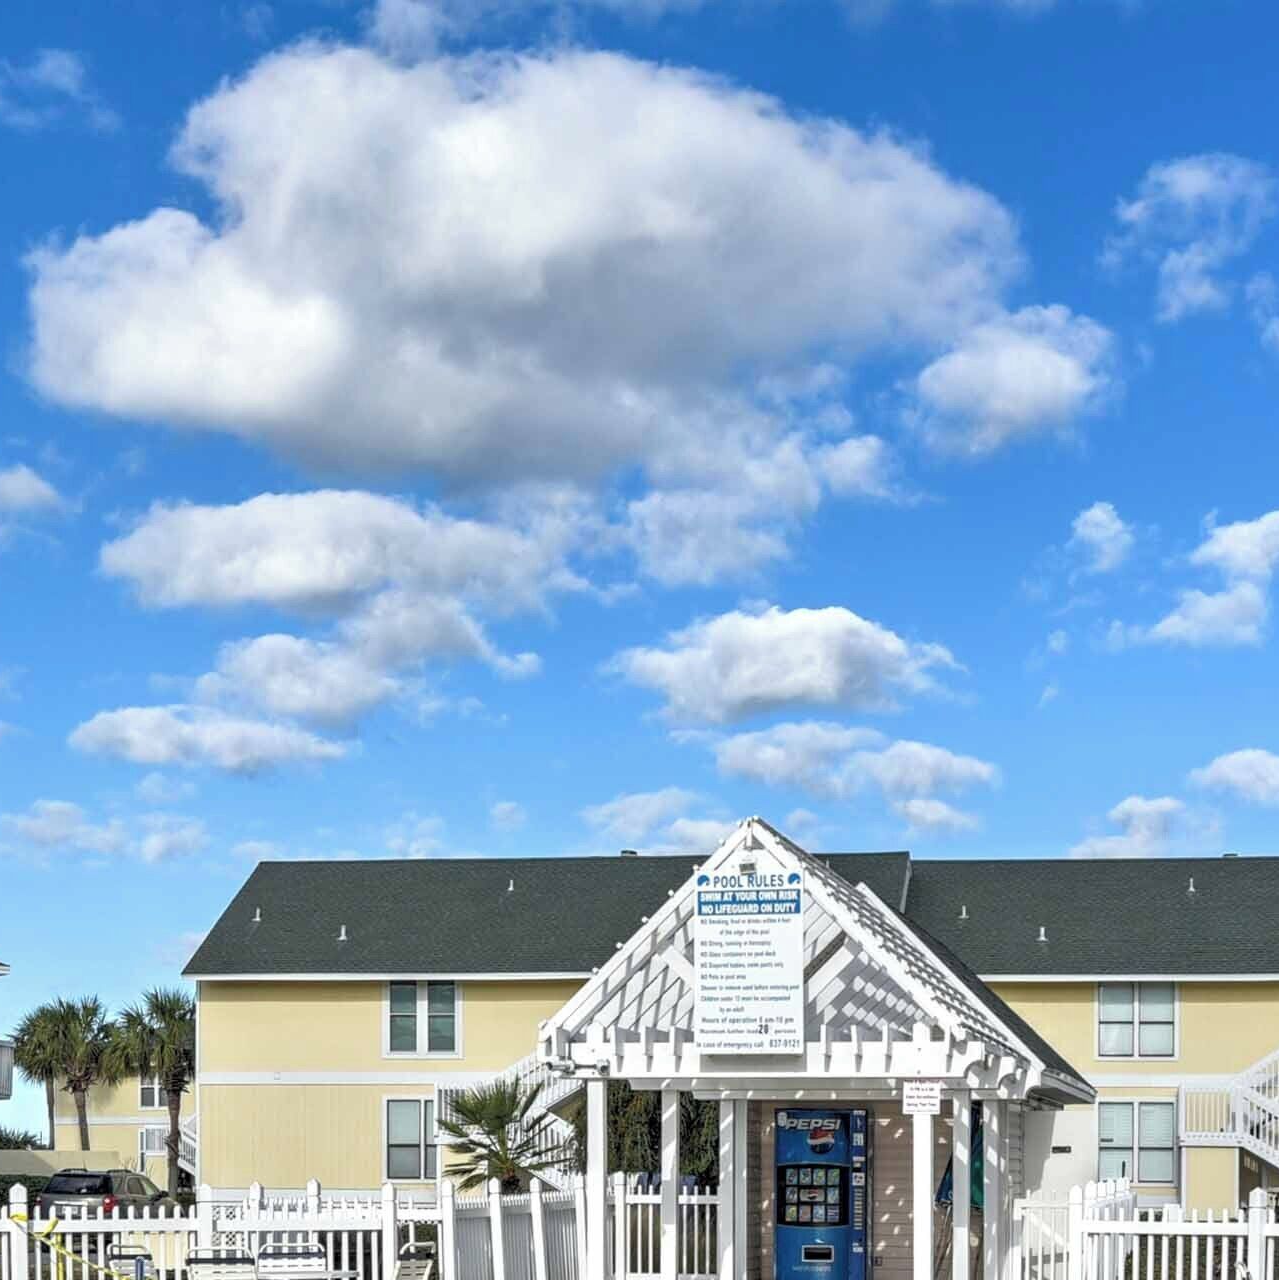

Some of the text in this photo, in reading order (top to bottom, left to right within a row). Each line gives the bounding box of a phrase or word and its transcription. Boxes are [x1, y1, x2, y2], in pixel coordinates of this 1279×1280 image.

[714, 874, 784, 888] POOL RULES
[701, 890, 798, 901] SWIM AT YOUR OWN RISK
[701, 903, 796, 914] NO LIFEGUARD ON DUTY
[786, 1119, 841, 1130] PEPSI
